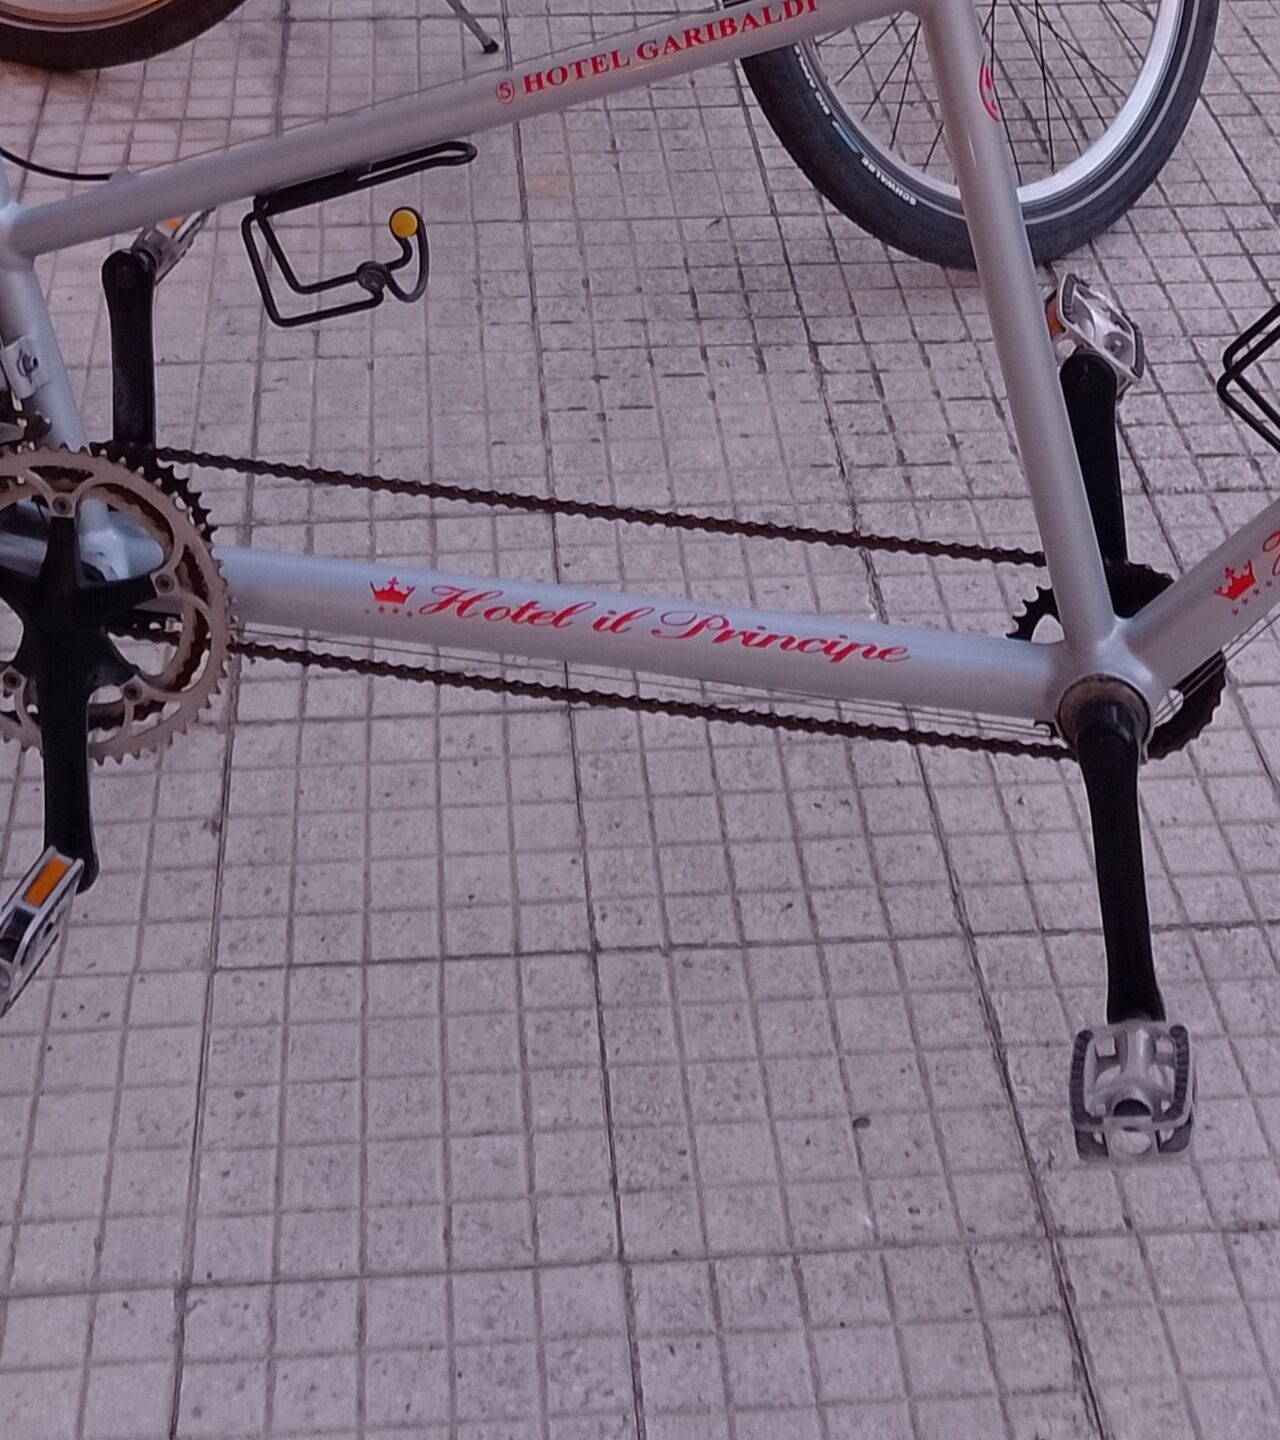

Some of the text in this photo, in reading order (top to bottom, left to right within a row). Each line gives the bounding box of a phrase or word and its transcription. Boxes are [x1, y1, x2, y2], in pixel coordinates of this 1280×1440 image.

[522, 48, 632, 96] HOTEL
[419, 584, 913, 664] Hotel il Principe
